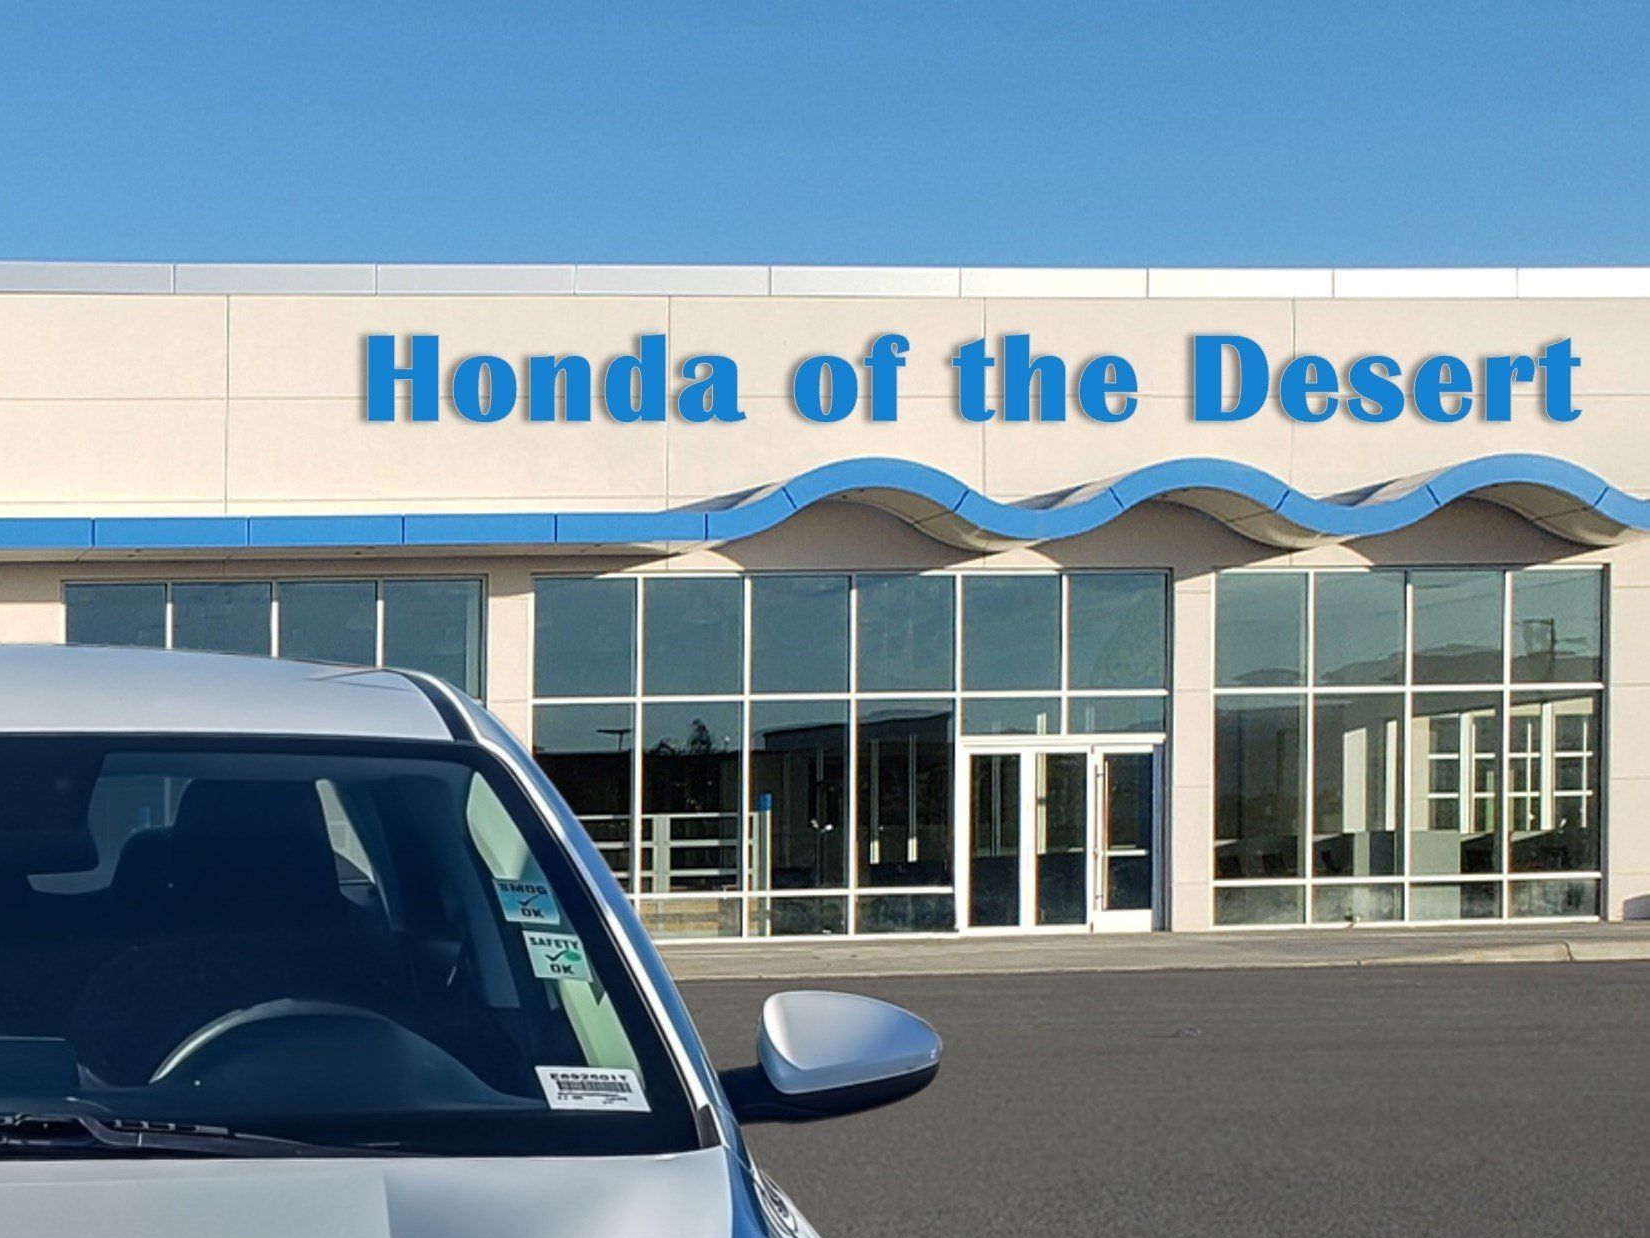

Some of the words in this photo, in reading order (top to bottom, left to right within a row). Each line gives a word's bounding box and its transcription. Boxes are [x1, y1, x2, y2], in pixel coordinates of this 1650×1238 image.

[366, 333, 746, 423] Honda
[793, 333, 910, 423] of
[951, 333, 1138, 423] the
[1193, 334, 1582, 423] Desert
[498, 883, 549, 895] SMOG
[521, 907, 545, 918] OK
[529, 937, 579, 950] SAFETY
[550, 963, 575, 975] OK
